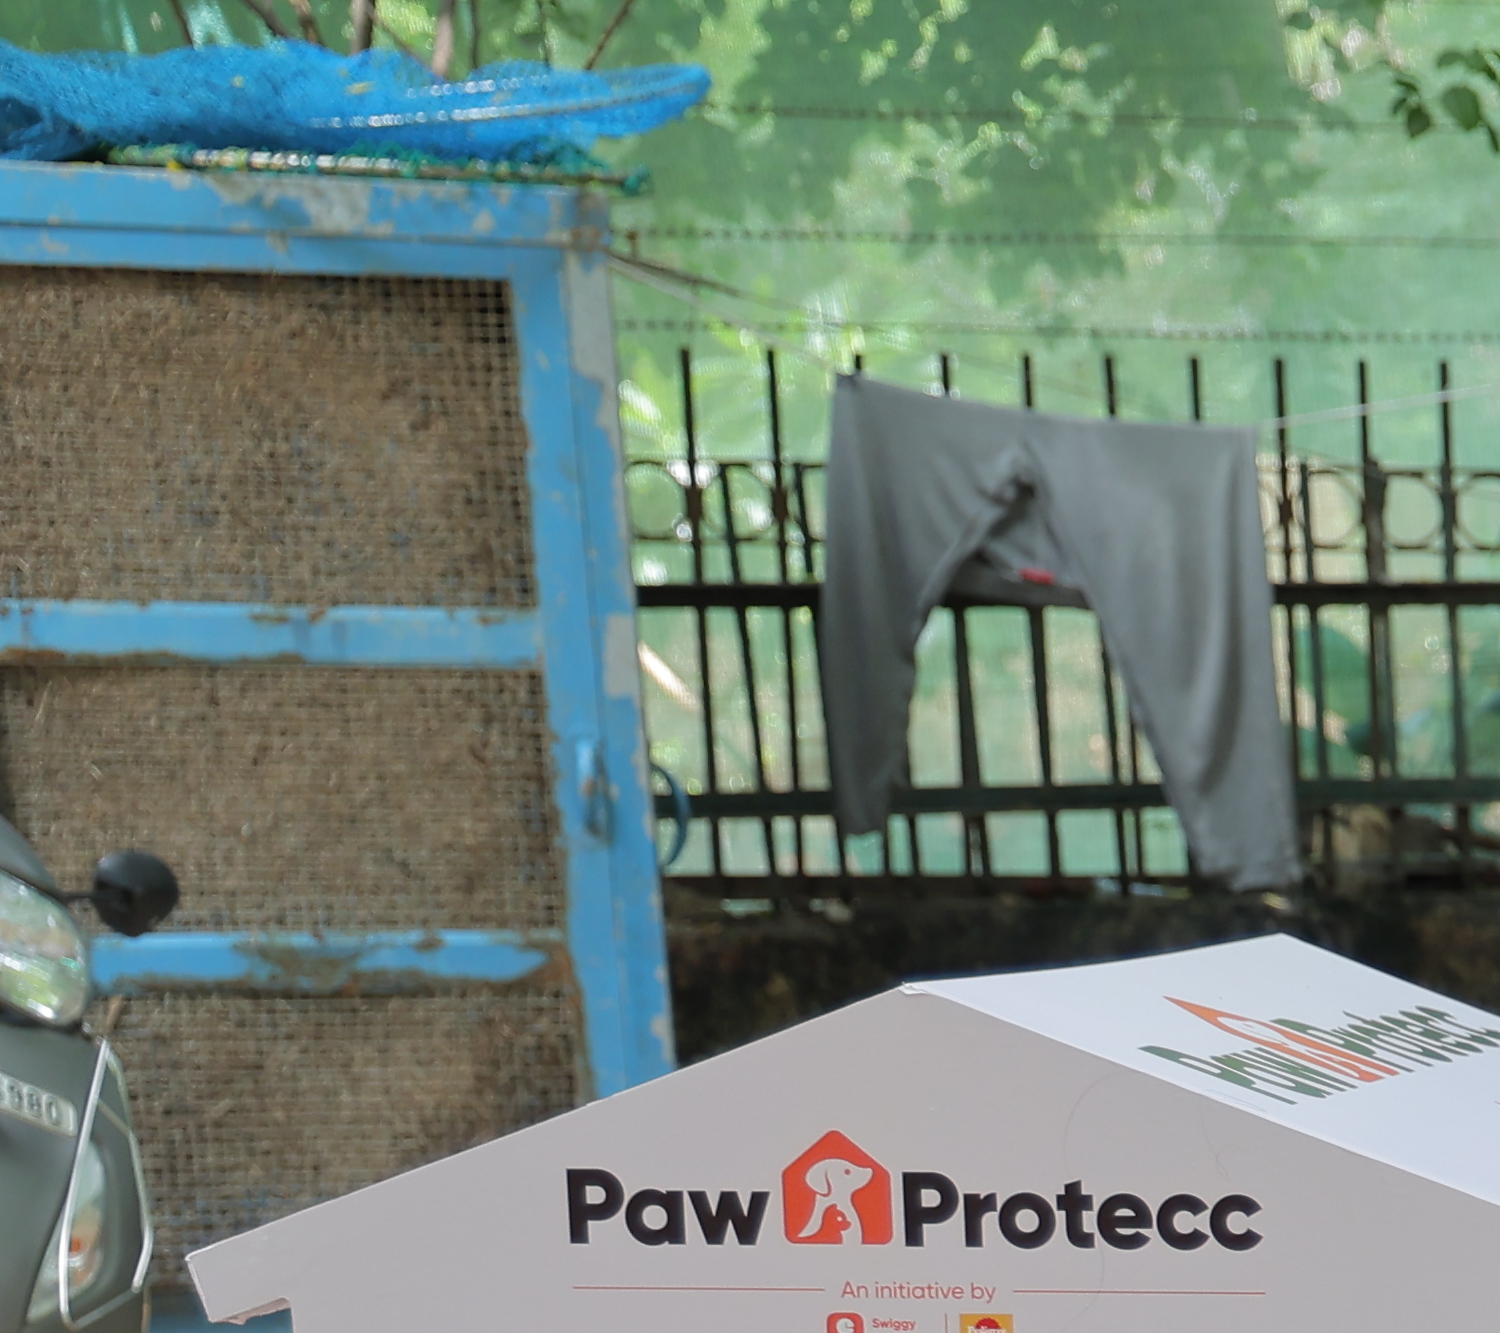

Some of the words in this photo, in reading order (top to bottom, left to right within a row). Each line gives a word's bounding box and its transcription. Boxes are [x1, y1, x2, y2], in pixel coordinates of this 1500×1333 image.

[1137, 1044, 1358, 1105] Paw
[566, 1167, 770, 1247] Paw
[901, 1170, 1264, 1252] Protecc
[840, 1281, 869, 1299] An
[875, 1281, 965, 1300] initiative
[970, 1282, 996, 1304] by
[872, 1318, 916, 1331] Swiggy
